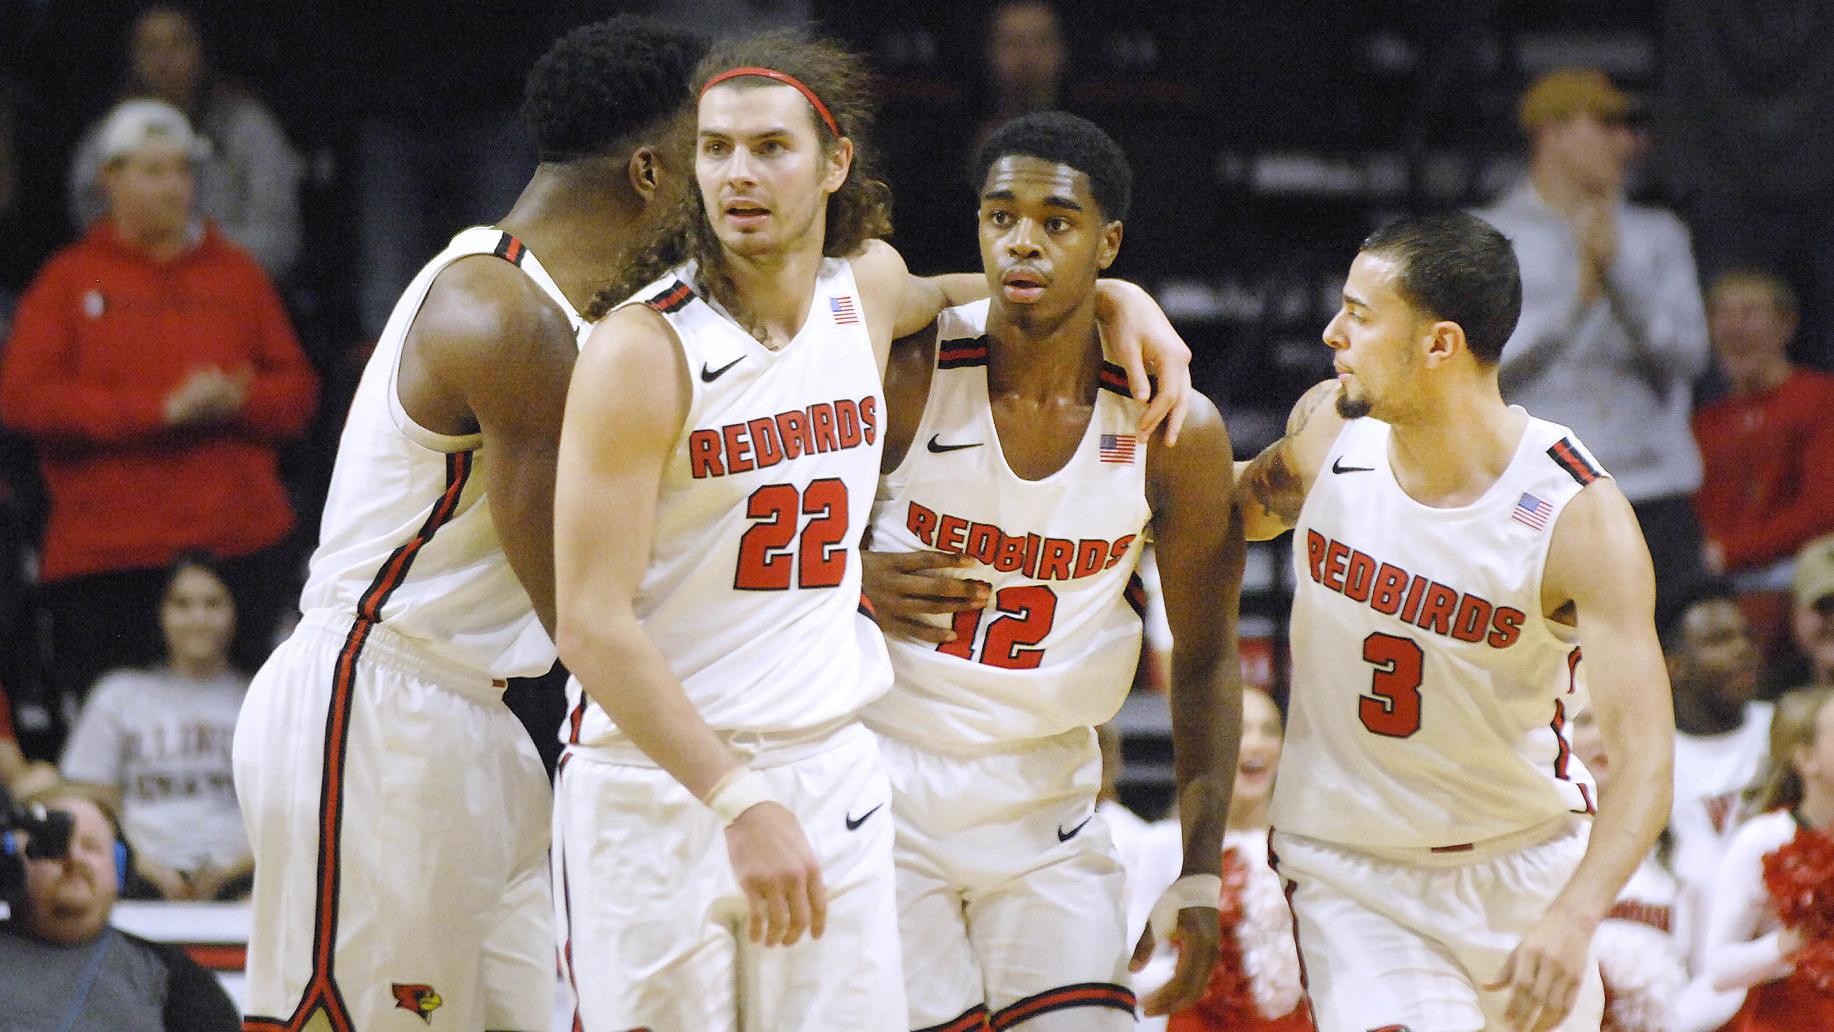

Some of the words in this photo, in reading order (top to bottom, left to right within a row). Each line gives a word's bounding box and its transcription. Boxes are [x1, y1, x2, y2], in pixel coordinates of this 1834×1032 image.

[689, 396, 877, 479] REDBIRDS
[733, 477, 849, 590] 22
[906, 500, 1137, 581] REDBIRDS
[1307, 528, 1526, 649] REDBIRDS
[1358, 631, 1425, 739] 3
